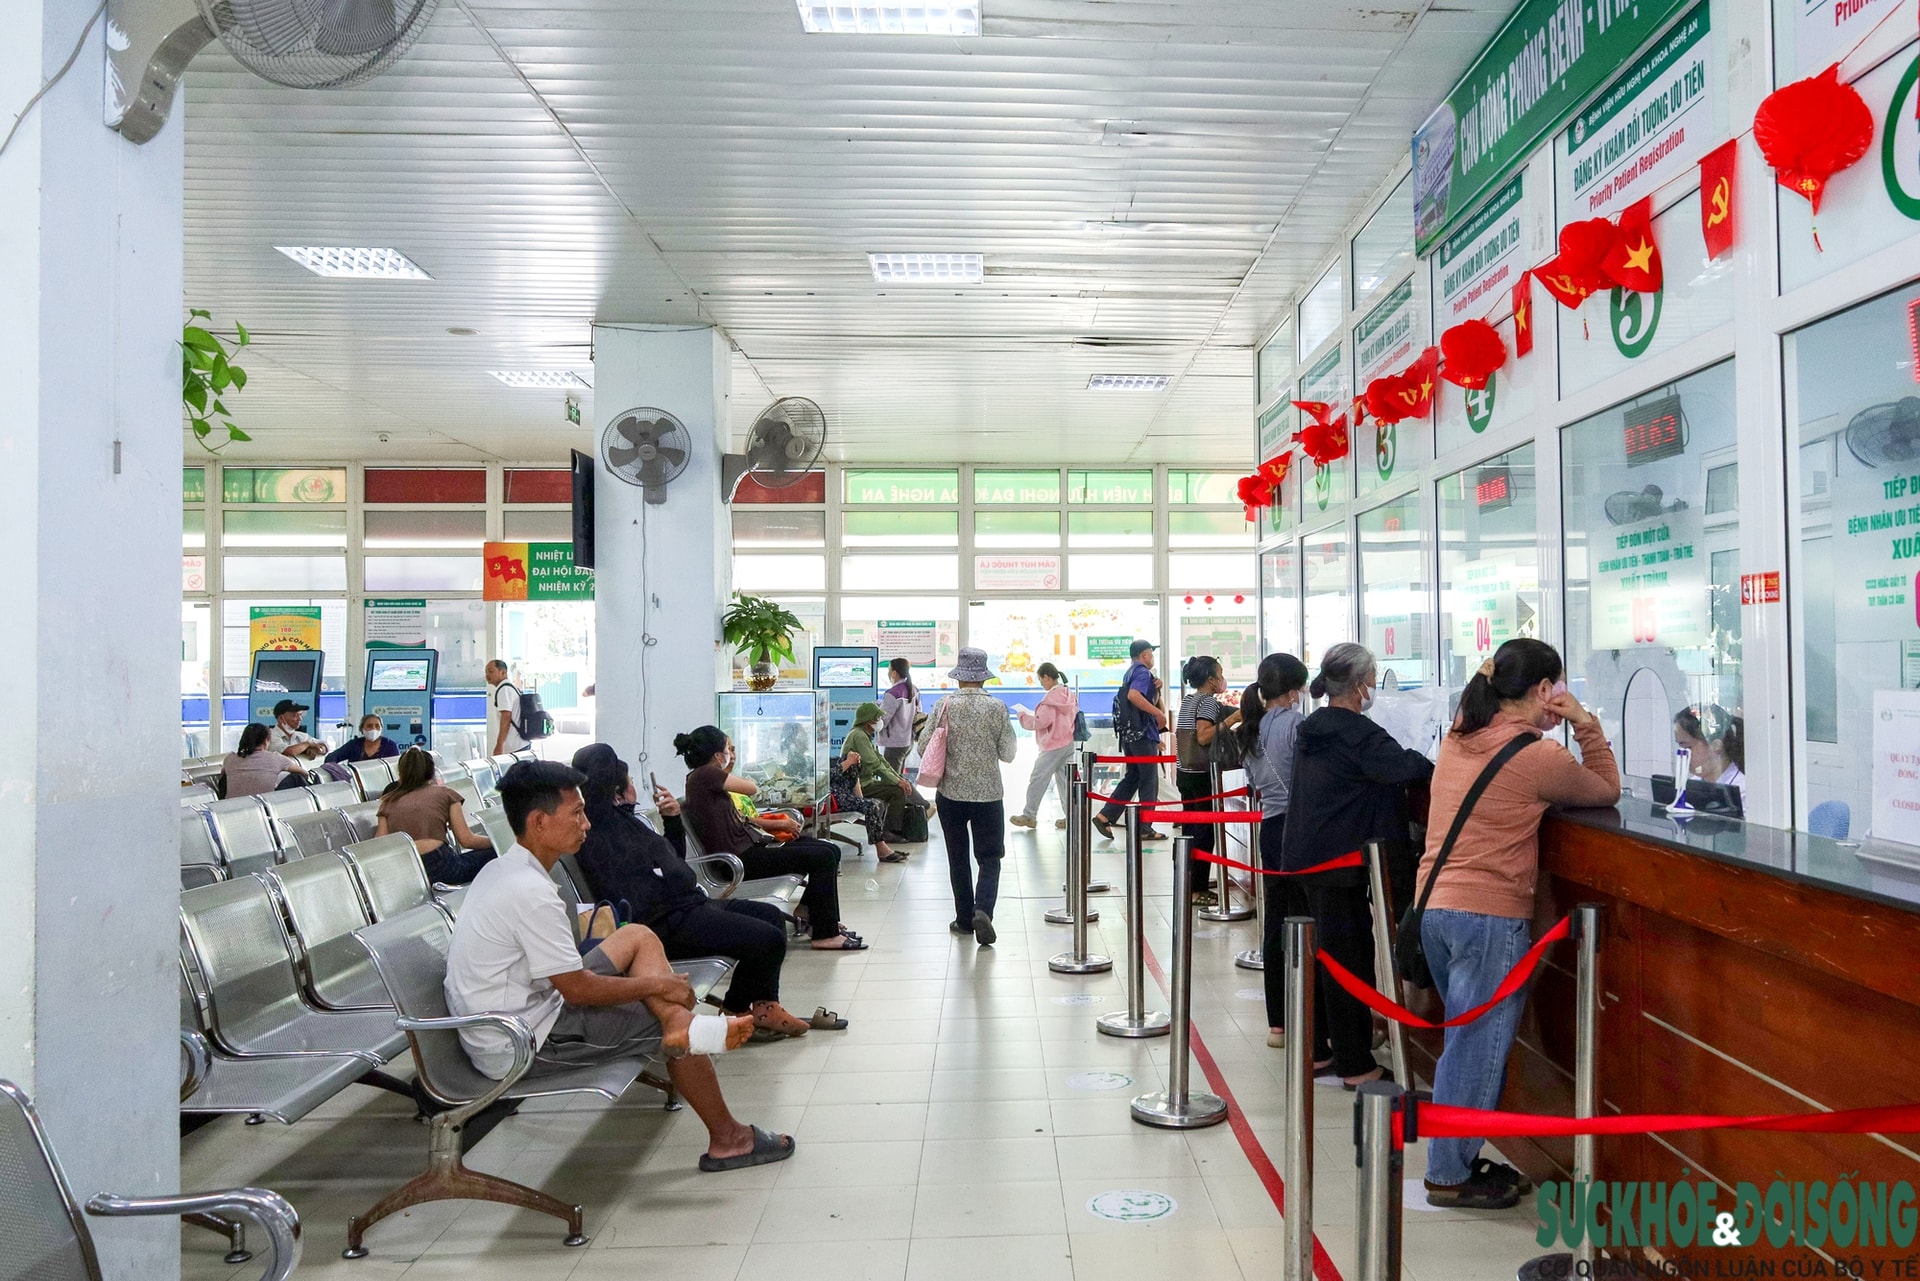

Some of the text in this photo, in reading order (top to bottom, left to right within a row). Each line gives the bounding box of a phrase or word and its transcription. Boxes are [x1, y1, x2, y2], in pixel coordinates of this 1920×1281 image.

[1460, 84, 1479, 176] CHỦ
[1480, 71, 1507, 162] ĐỘNG
[1508, 29, 1548, 127] PHÒNG
[1550, 0, 1585, 90] BỆNH
[1602, 93, 1614, 113] VIỆN
[1614, 85, 1626, 103] HỮU
[1626, 70, 1642, 94] NGHỊ
[1642, 65, 1650, 79] ĐA
[1651, 47, 1669, 70] KHOA
[1669, 26, 1688, 53] NGHỆ
[1687, 18, 1698, 36] AN
[1574, 60, 1704, 192] ĐĂNG KÝ KHÁM ĐỐI TƯỢNG ƯU TIÊN
[1589, 127, 1685, 213] Priority Patient Registration
[1618, 286, 1655, 346] 5
[1848, 515, 1869, 538] BỆNH
[1870, 510, 1893, 532] NHÂN
[532, 567, 550, 578] ĐẠI
[553, 565, 572, 578] HỘI
[535, 550, 564, 563] NHIỆT
[538, 581, 571, 594] NHIỆM
[1476, 616, 1491, 652] 04
